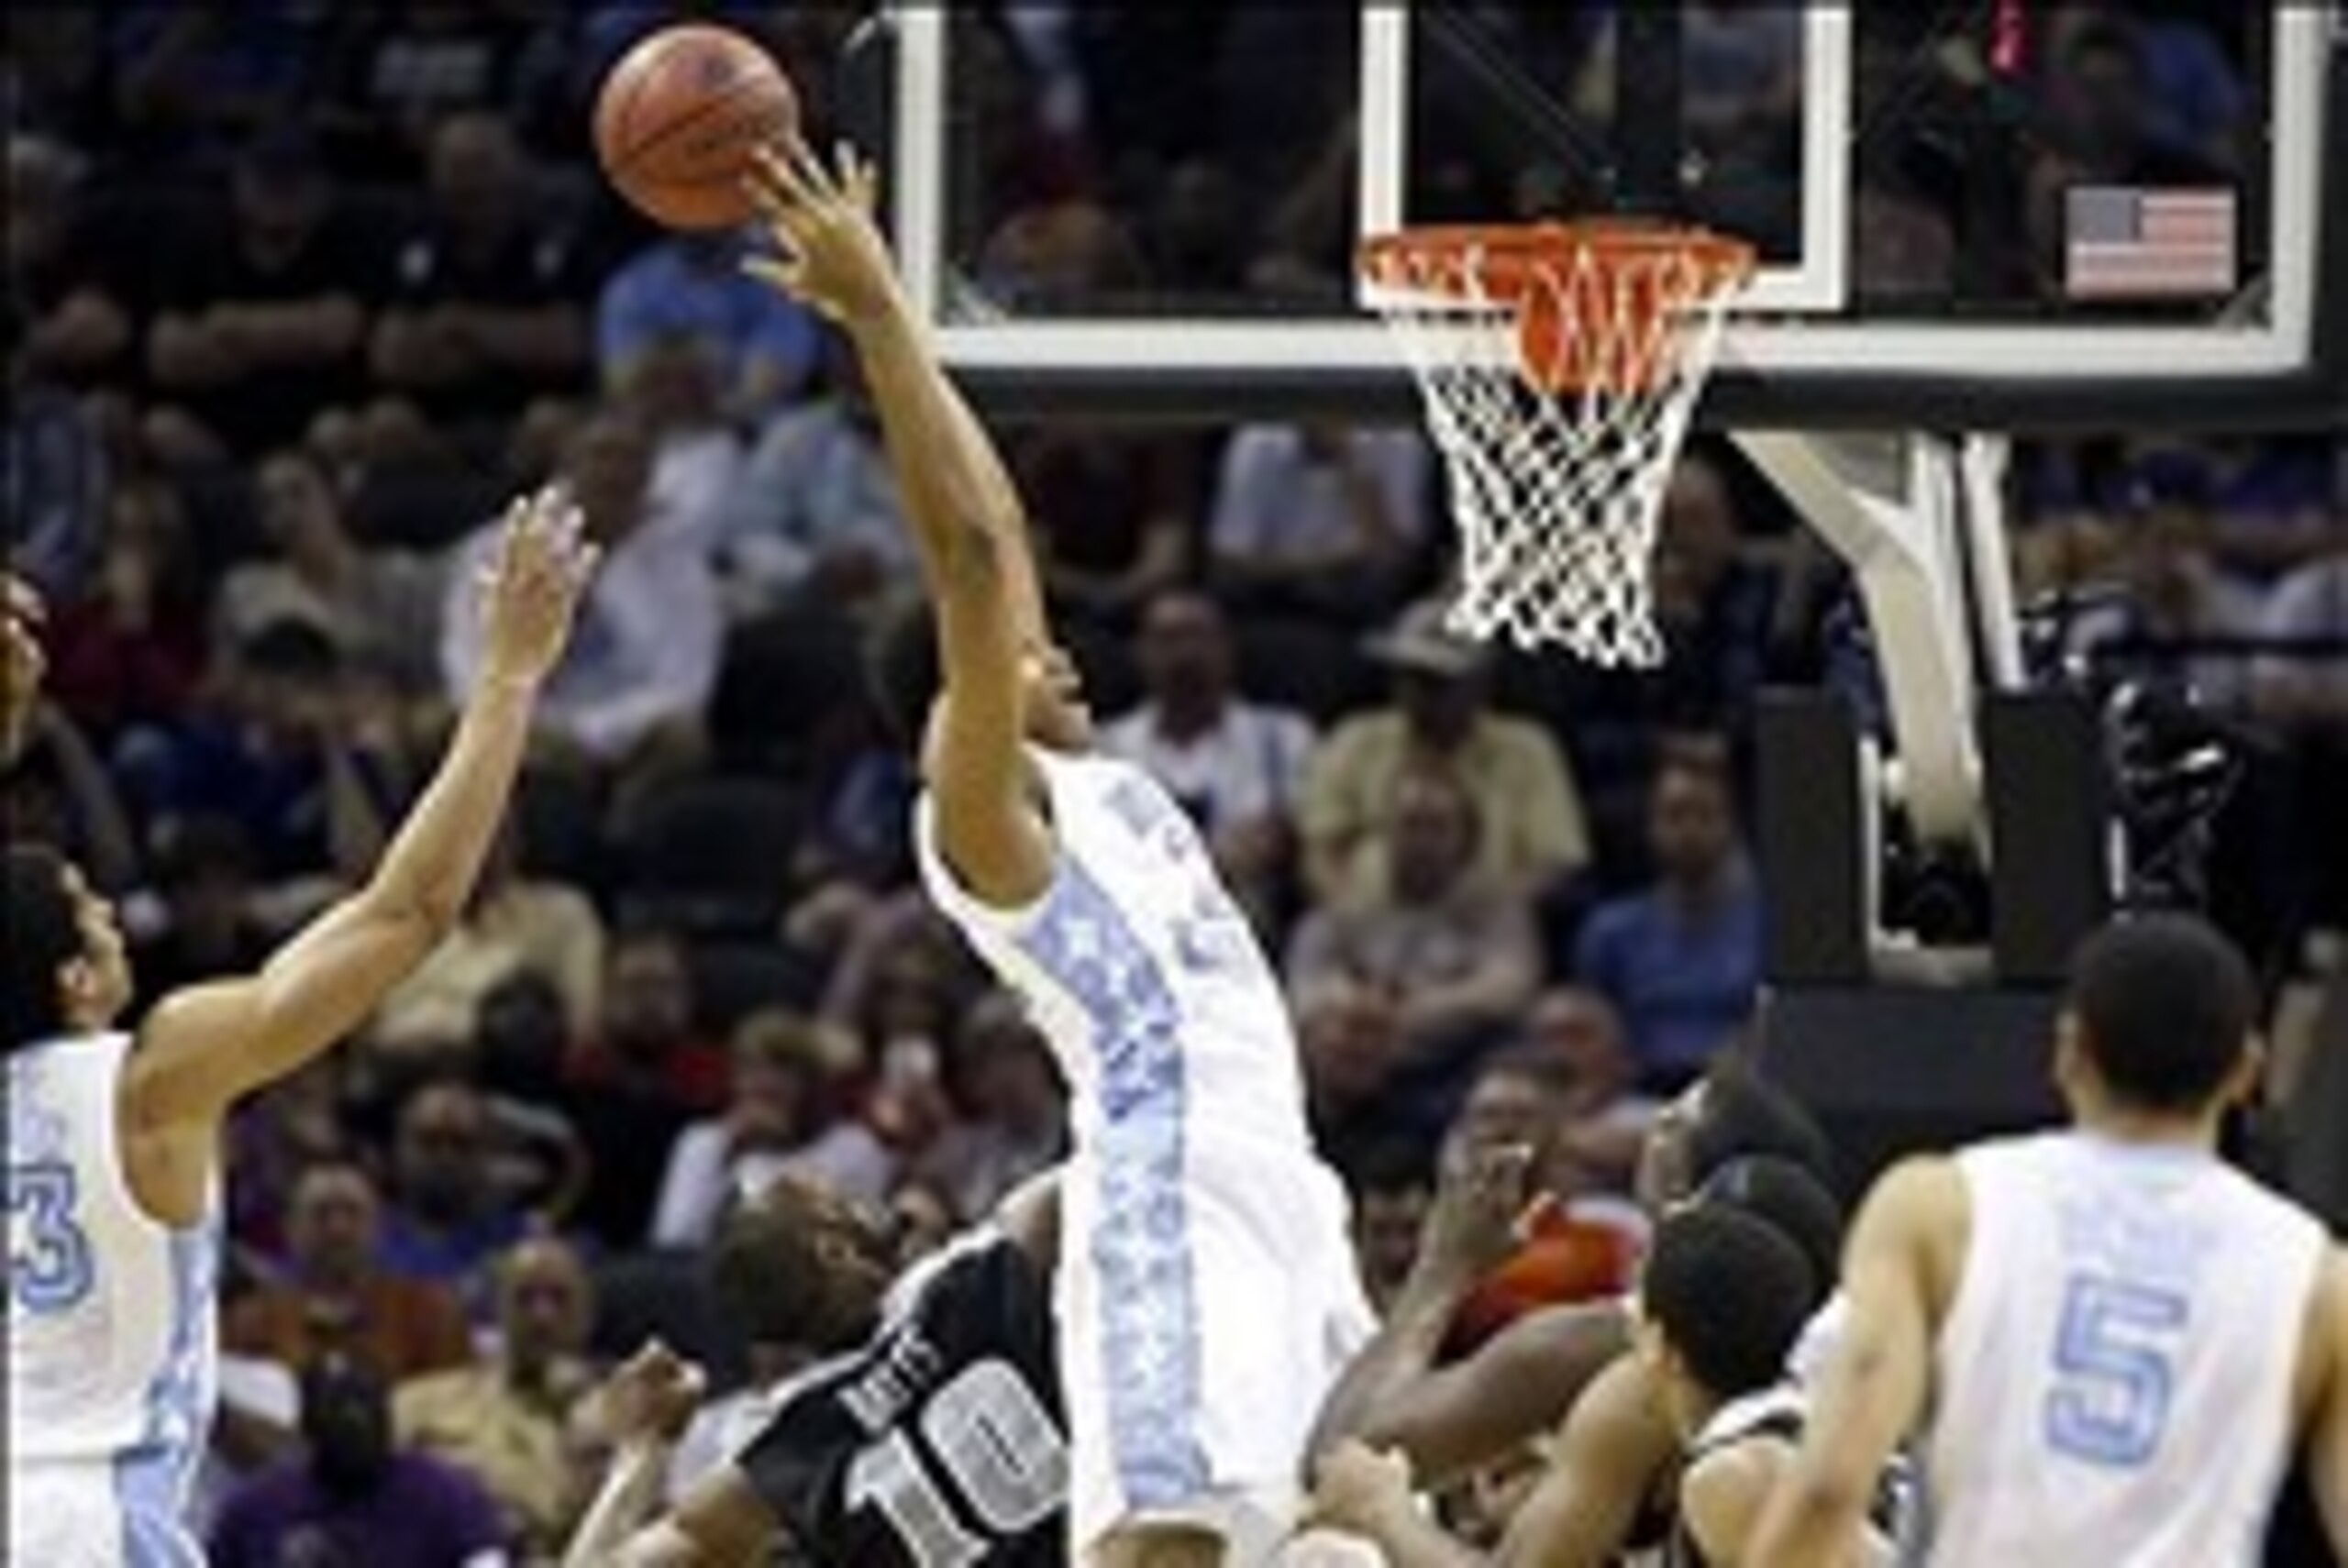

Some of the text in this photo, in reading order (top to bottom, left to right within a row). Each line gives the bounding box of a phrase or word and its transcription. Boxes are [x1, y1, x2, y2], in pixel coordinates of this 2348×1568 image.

[7, 1164, 94, 1312] 3
[846, 1356, 1070, 1566] 10
[2044, 1274, 2189, 1468] 5
